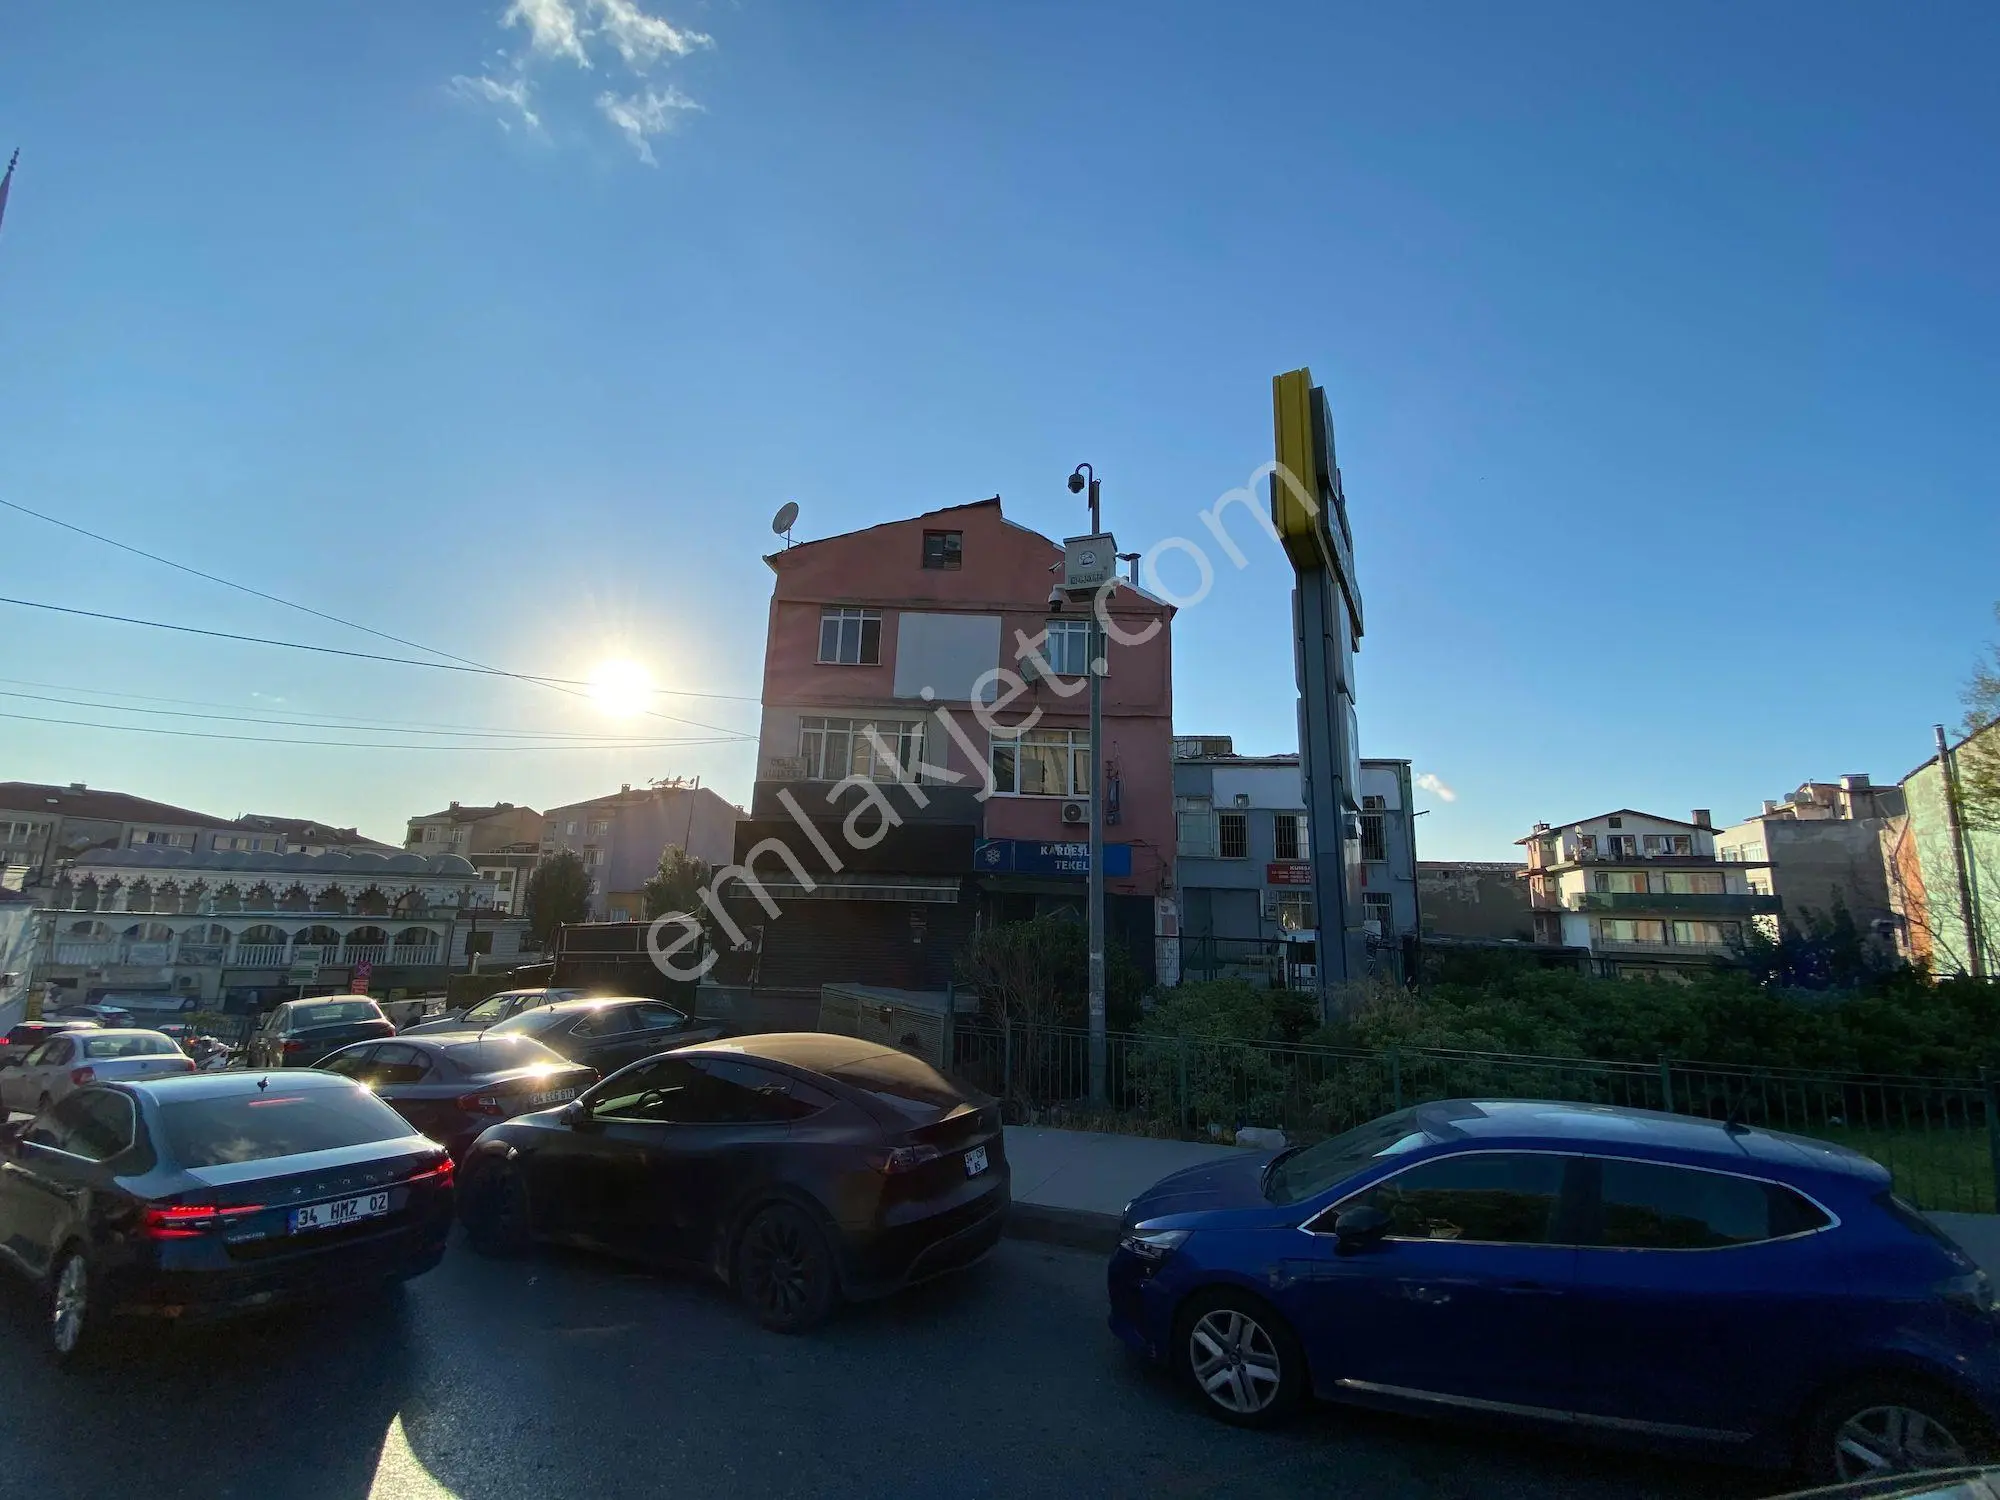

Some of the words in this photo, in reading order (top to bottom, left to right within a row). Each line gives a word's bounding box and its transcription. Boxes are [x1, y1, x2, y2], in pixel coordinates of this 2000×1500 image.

[1054, 859, 1090, 871] TEKEL
[299, 1208, 318, 1226] 34
[330, 1199, 358, 1222] HMZ
[370, 1194, 386, 1212] 02
